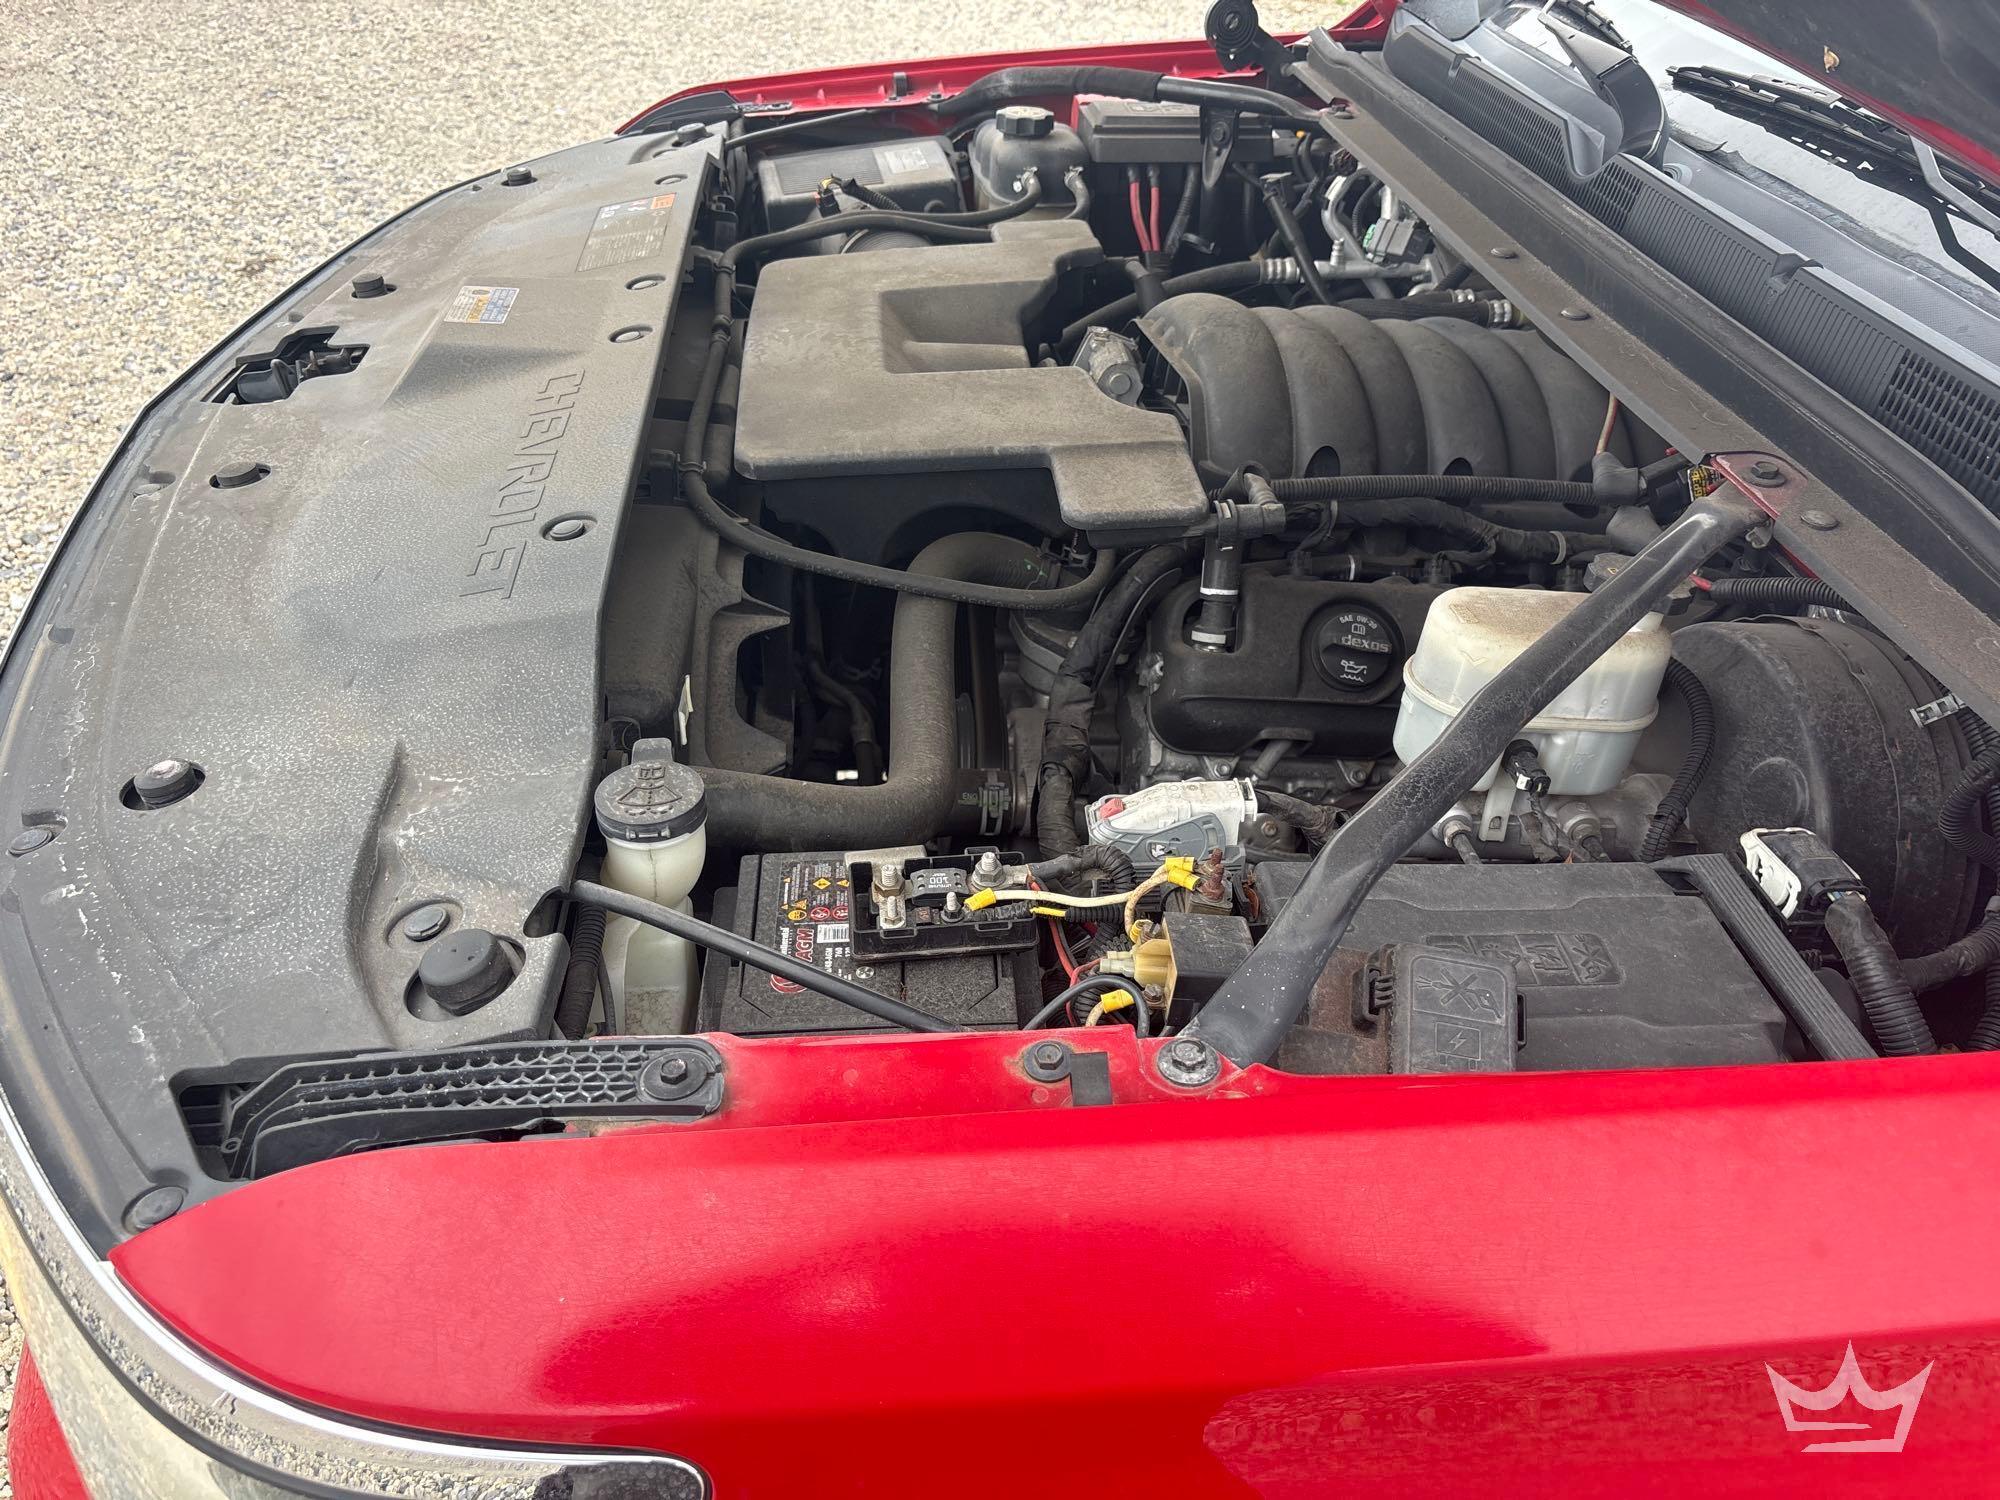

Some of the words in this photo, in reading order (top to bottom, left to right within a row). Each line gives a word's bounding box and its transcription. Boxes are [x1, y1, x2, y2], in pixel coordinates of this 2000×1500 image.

[458, 369, 586, 600] CHEVROLET
[1339, 614, 1353, 624] SAE
[1356, 615, 1378, 630] 0W-20
[1341, 634, 1389, 652] dexos
[794, 928, 815, 963] AGM
[834, 947, 843, 958] 760
